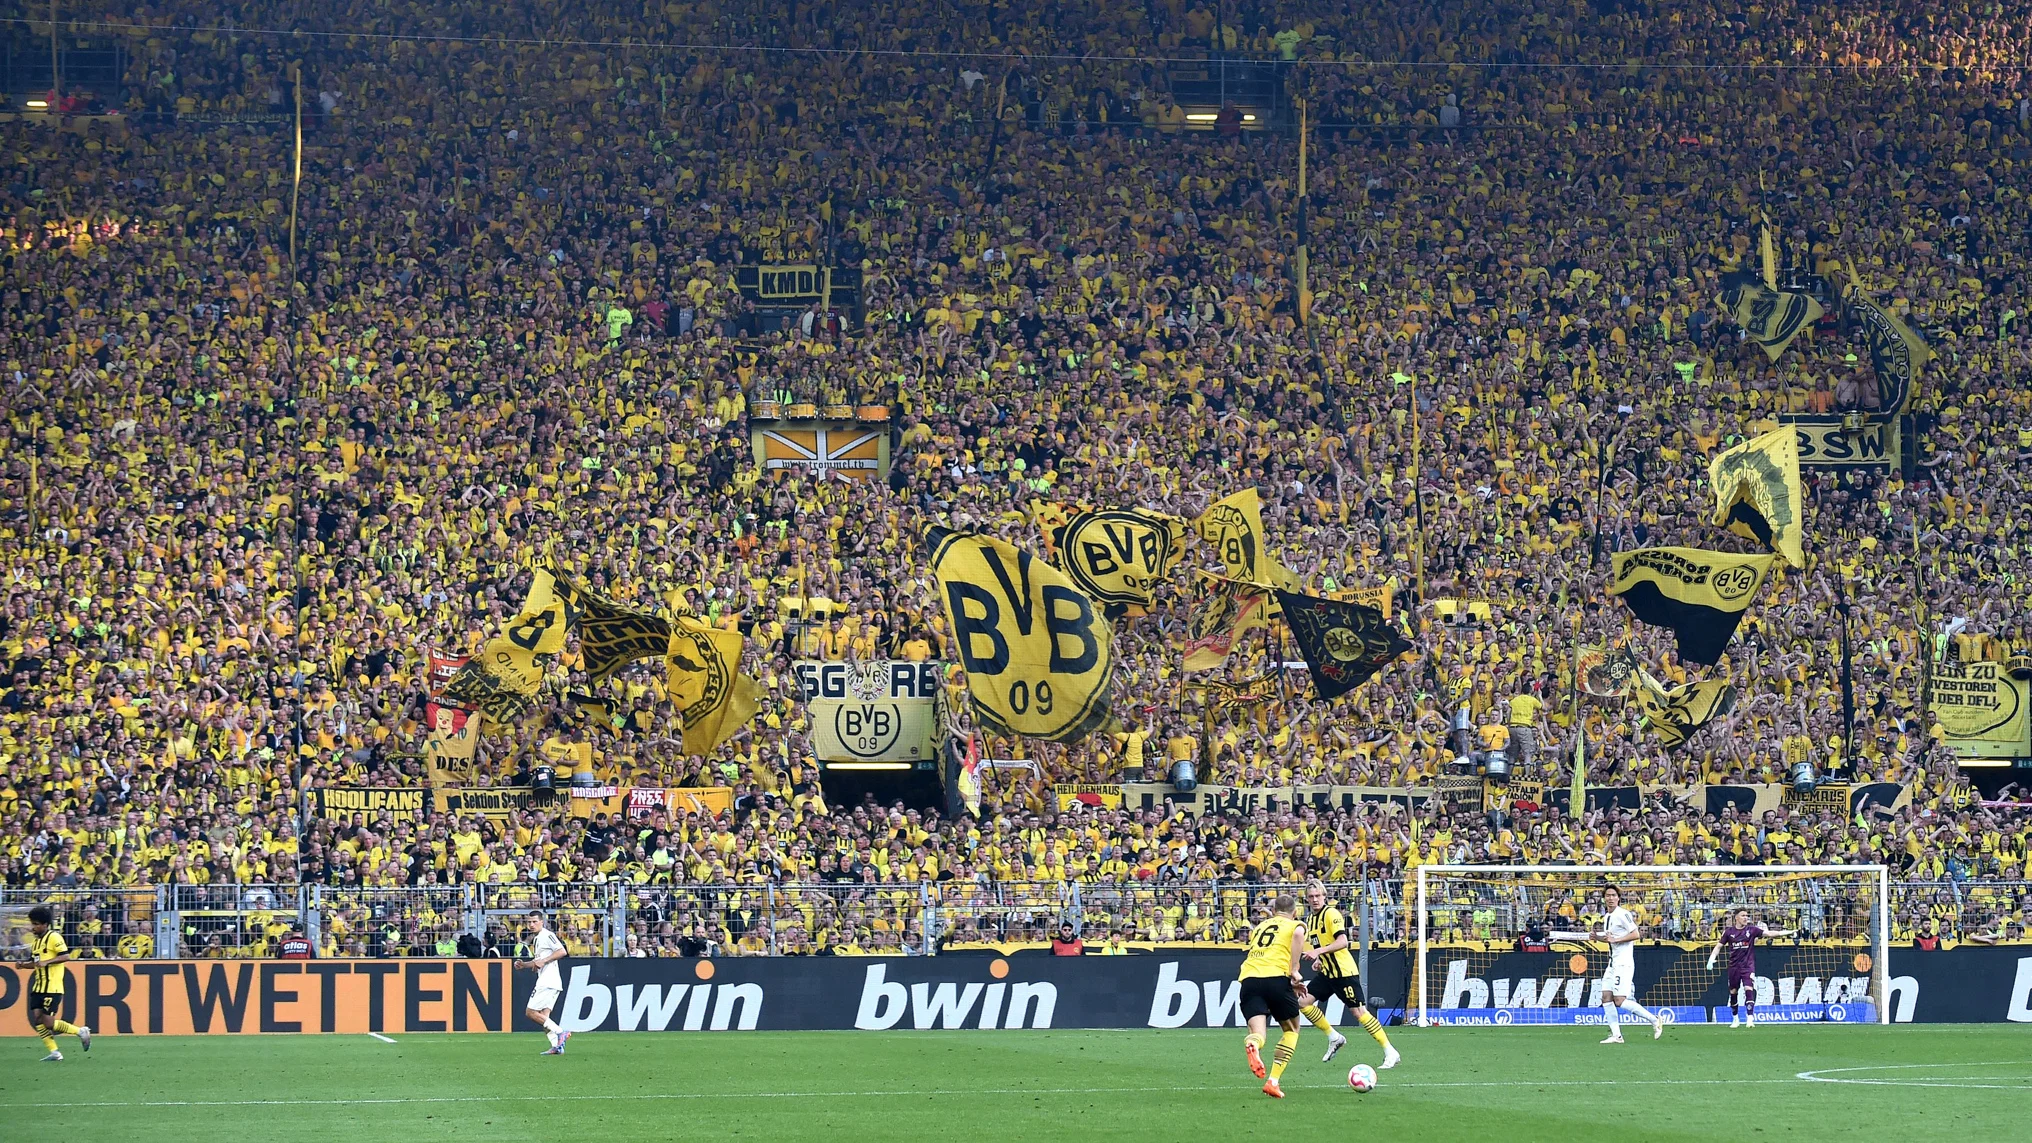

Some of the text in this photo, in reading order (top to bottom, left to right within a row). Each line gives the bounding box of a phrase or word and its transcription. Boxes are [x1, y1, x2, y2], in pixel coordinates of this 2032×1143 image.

[1081, 524, 1157, 576] BVB
[1342, 589, 1383, 601] BORUSSIA
[946, 546, 1098, 675] BVB
[1327, 631, 1361, 652] BVB
[434, 665, 460, 676] LIF
[1932, 665, 1996, 679] EIN ZU
[1931, 680, 1996, 692] VESTOREN
[1009, 680, 1054, 715] 09
[1938, 693, 1963, 705] DER
[1967, 694, 1997, 707] DFL!
[846, 704, 890, 737] BVB
[858, 736, 878, 749] 09
[1056, 784, 1120, 796] HEILIGENHAUS
[1786, 789, 1845, 802] NIEMALS
[323, 789, 423, 810] HOOLIGANS
[463, 792, 500, 809] Sektion
[631, 790, 664, 806] FREE
[1250, 924, 1279, 948] 6
[284, 941, 308, 950] atlas
[1614, 975, 1621, 986] 3
[560, 959, 764, 1031] bwin
[855, 958, 1057, 1030] bwin
[1147, 961, 1346, 1028] bw
[1343, 987, 1354, 998] 19
[1410, 1016, 1491, 1025] SNAL IDUNA
[1574, 1014, 1650, 1024] SIGNA IDUN
[1754, 1011, 1789, 1022] IGNAL
